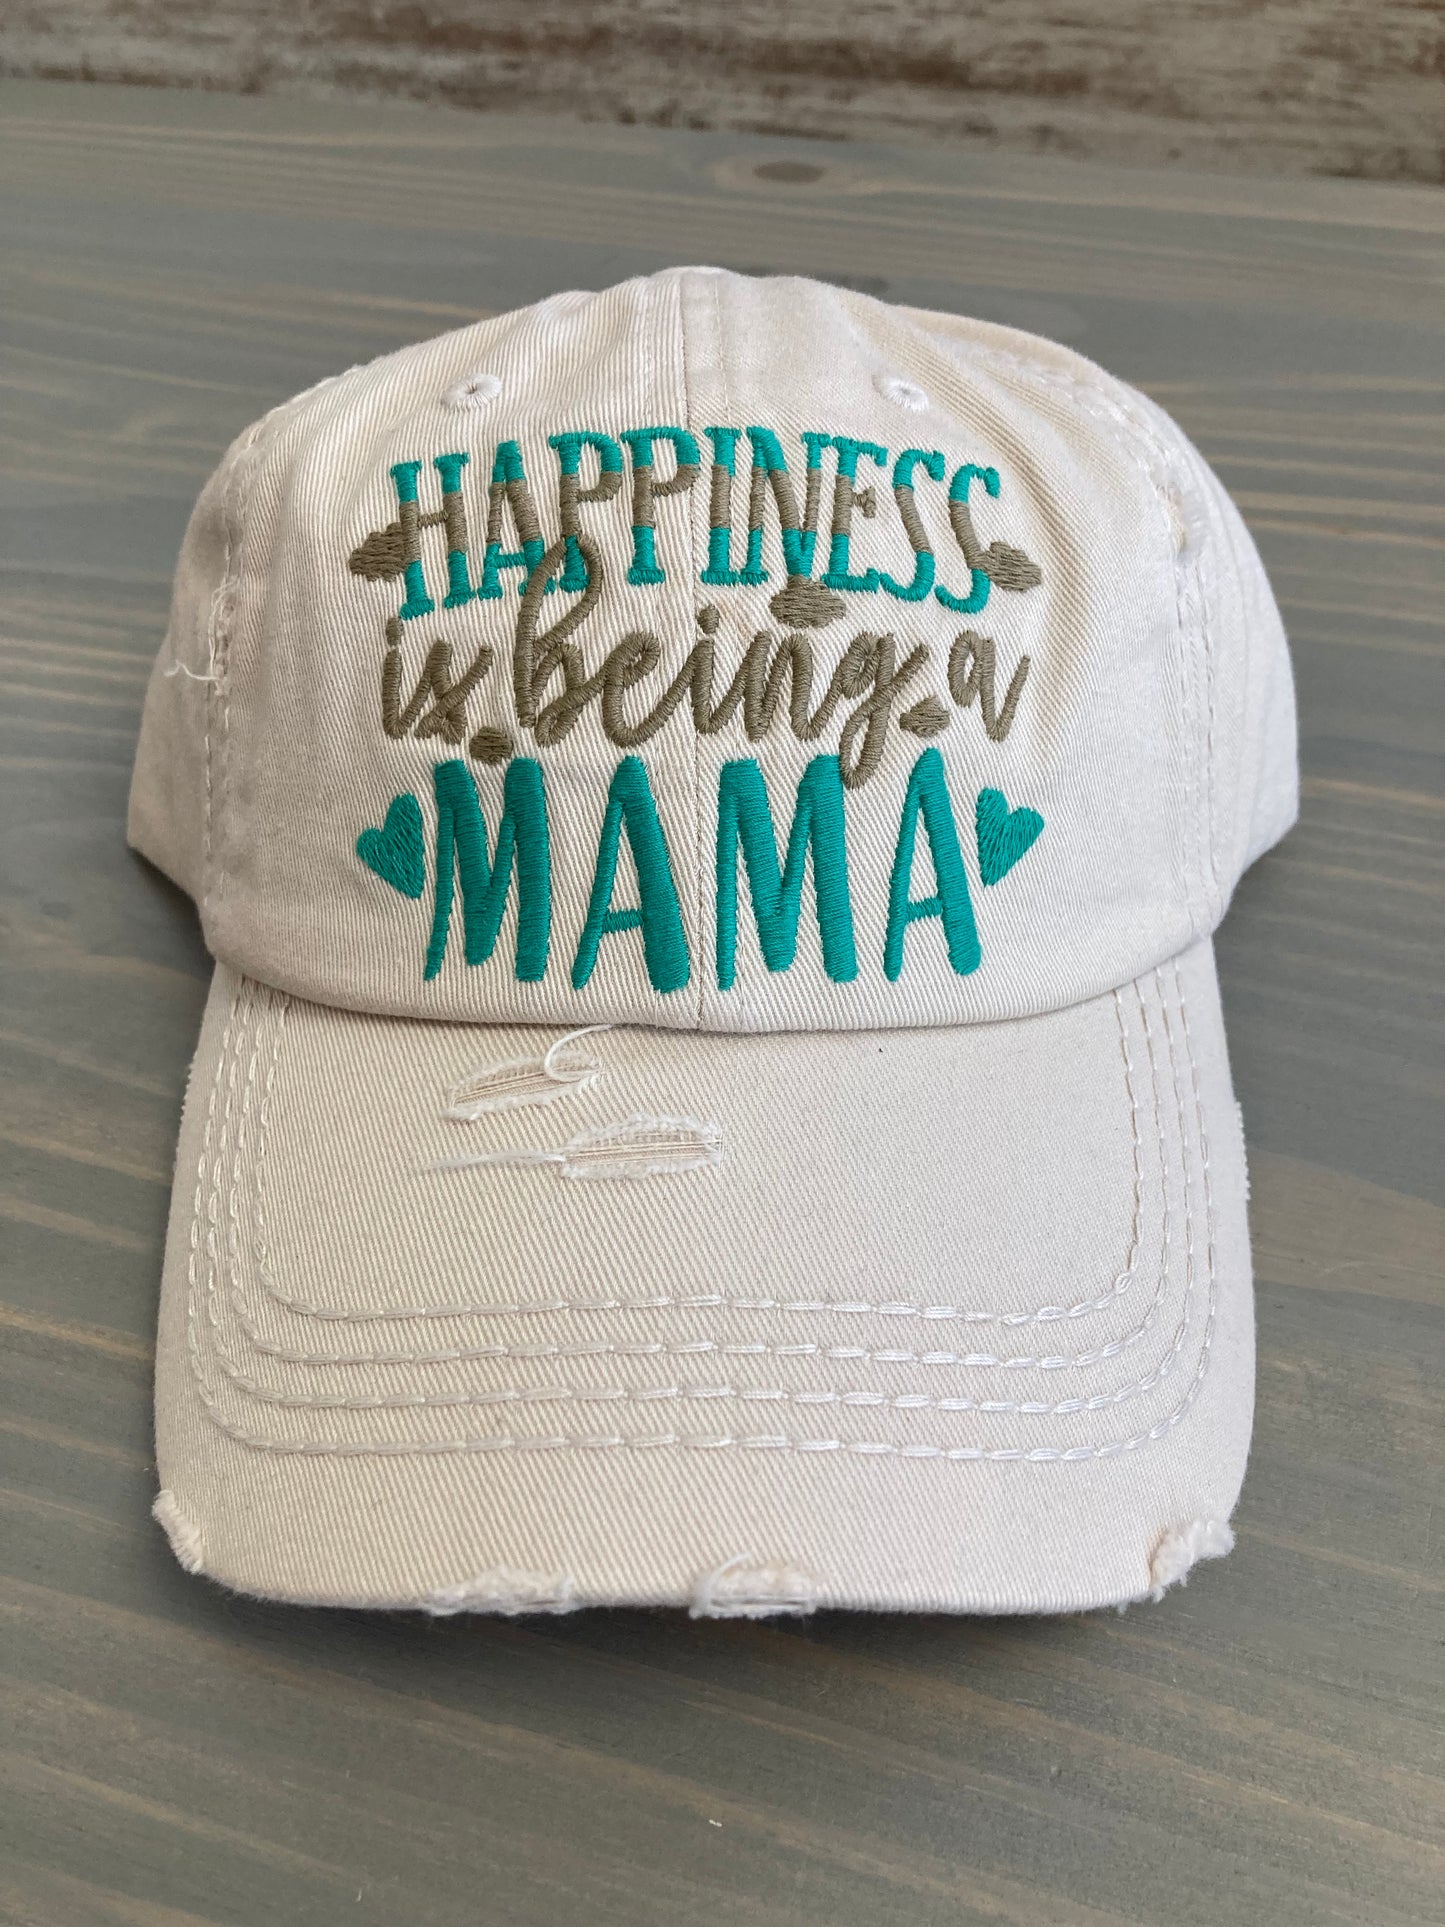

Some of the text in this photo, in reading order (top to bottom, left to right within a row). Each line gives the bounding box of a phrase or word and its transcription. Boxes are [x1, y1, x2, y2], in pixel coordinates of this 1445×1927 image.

[390, 425, 1000, 620] HAPPINESS
[381, 537, 1031, 790] is being a
[423, 747, 982, 994] MAMA
